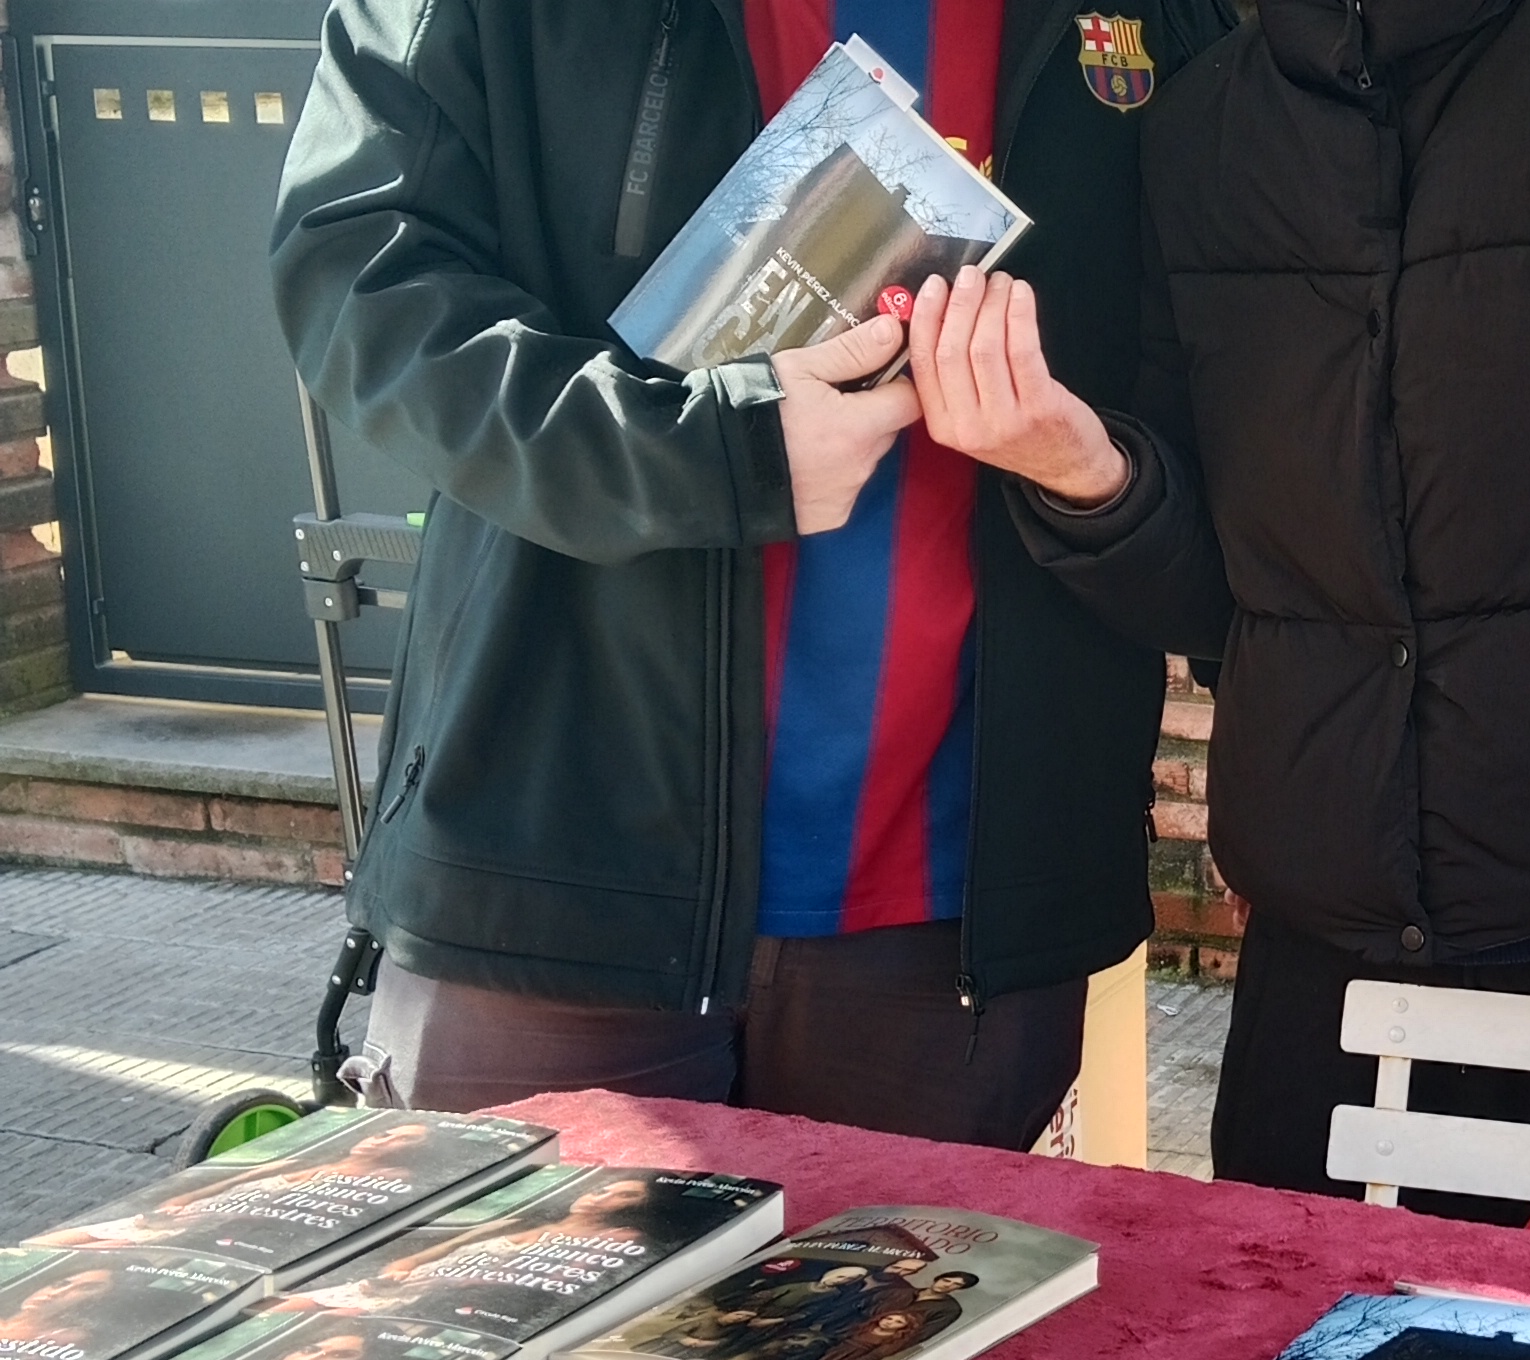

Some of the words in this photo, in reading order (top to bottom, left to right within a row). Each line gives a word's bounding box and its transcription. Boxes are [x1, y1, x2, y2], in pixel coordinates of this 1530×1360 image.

[1101, 53, 1129, 68] FCB
[626, 169, 649, 196] FC
[775, 246, 804, 279] KEVIN
[802, 268, 832, 303] PÉREZ
[275, 1191, 364, 1219] flores
[291, 1181, 389, 1206] blanco
[502, 1254, 602, 1284] flores
[519, 1242, 625, 1269] blanco
[429, 1263, 582, 1297] silvestres
